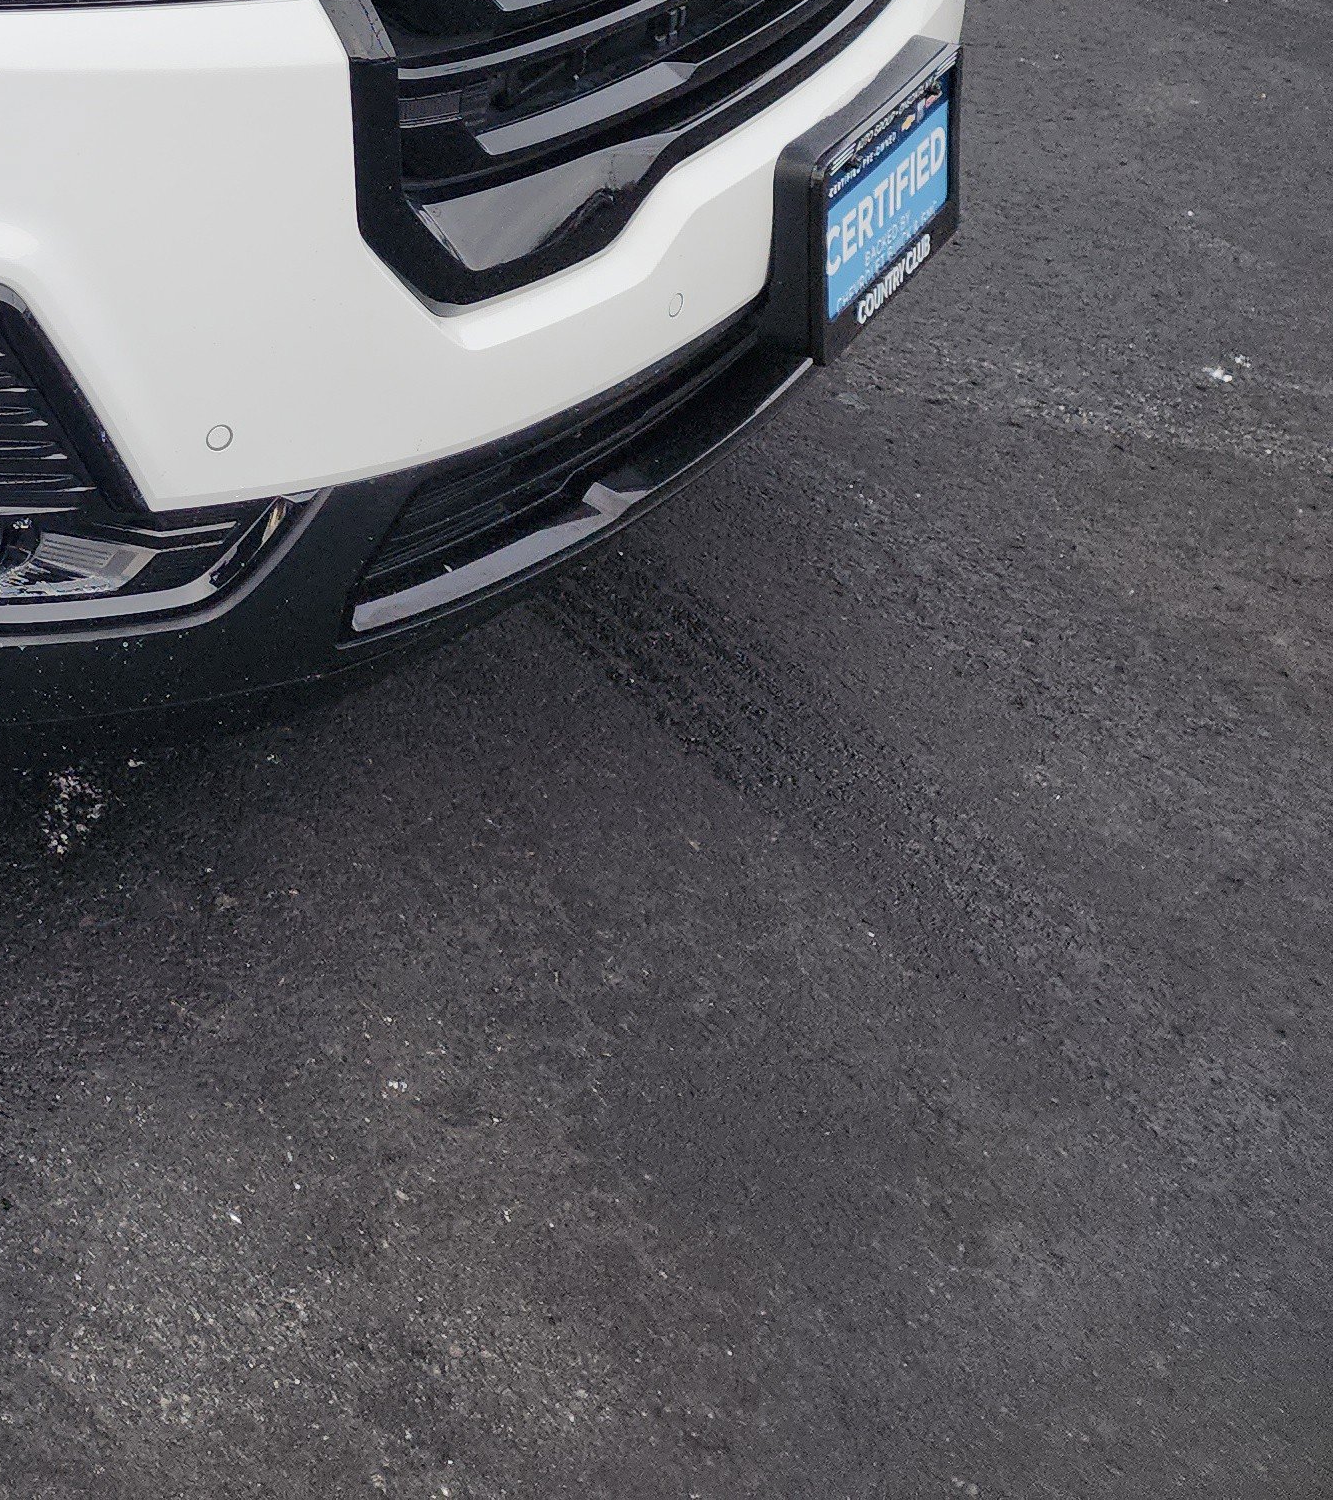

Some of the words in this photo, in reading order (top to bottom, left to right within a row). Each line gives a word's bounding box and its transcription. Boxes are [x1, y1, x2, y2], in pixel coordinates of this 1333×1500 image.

[825, 126, 946, 277] CERTIFIED
[864, 222, 899, 268] BACKED
[856, 257, 906, 325] COUNTRY
[905, 233, 931, 275] CLUB
